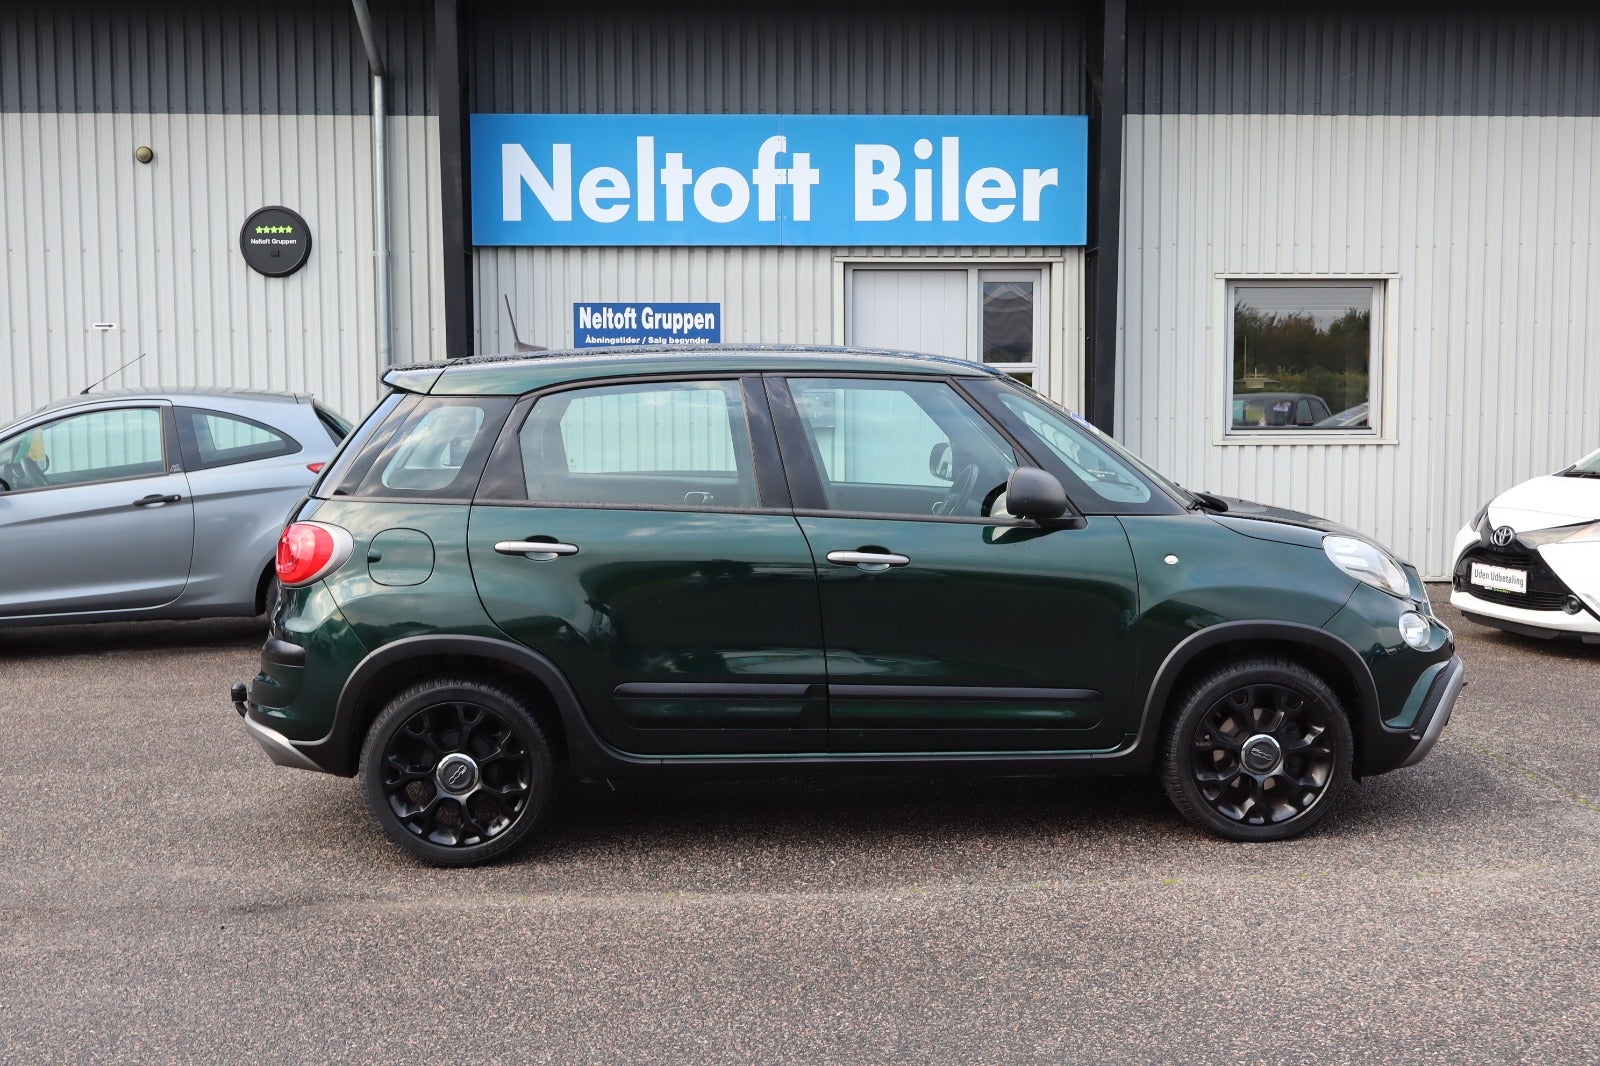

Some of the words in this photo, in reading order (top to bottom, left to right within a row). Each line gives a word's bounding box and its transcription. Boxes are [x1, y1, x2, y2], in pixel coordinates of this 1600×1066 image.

[501, 135, 820, 223] Neltoft
[854, 136, 1059, 223] Biler
[579, 306, 637, 330] Neltoft
[641, 306, 715, 335] Gruppen
[585, 334, 640, 345] Åbningstider
[648, 336, 667, 345] Salg
[1474, 568, 1490, 580] Uden
[1490, 571, 1524, 588] Udbetaling
